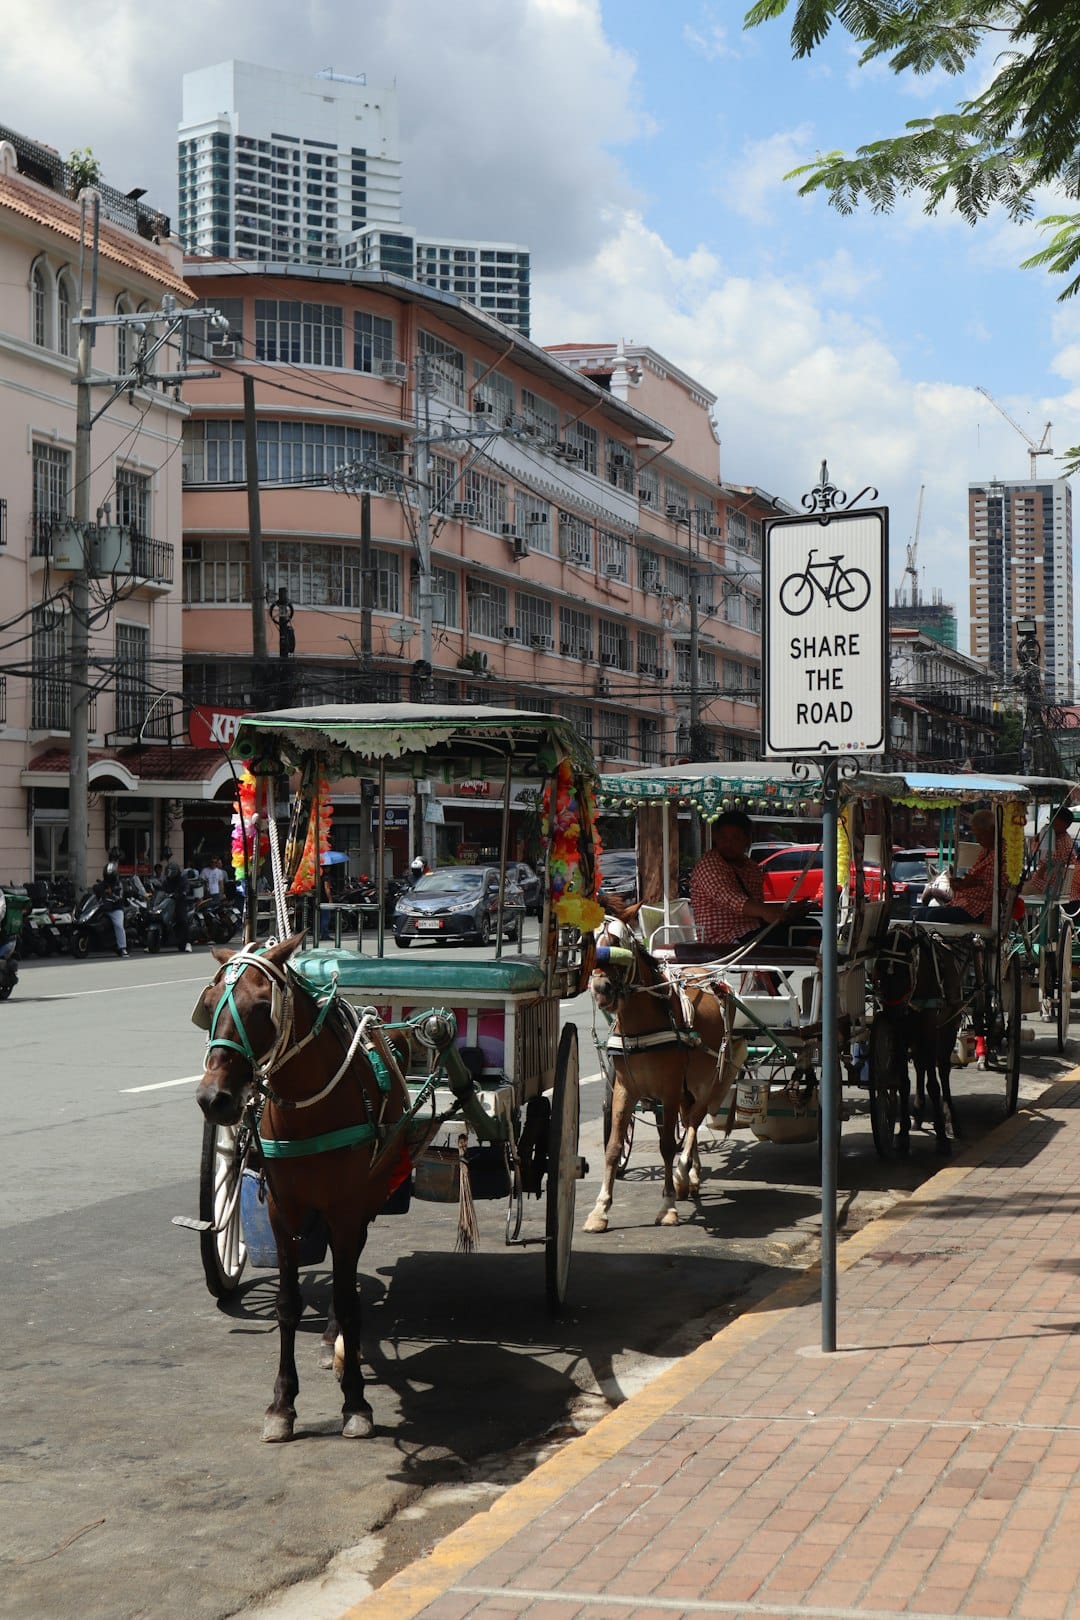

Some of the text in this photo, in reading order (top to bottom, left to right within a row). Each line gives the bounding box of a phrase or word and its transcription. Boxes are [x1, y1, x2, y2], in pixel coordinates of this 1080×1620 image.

[790, 633, 860, 660] SHARE
[805, 668, 844, 691] THE
[796, 701, 853, 725] ROAD
